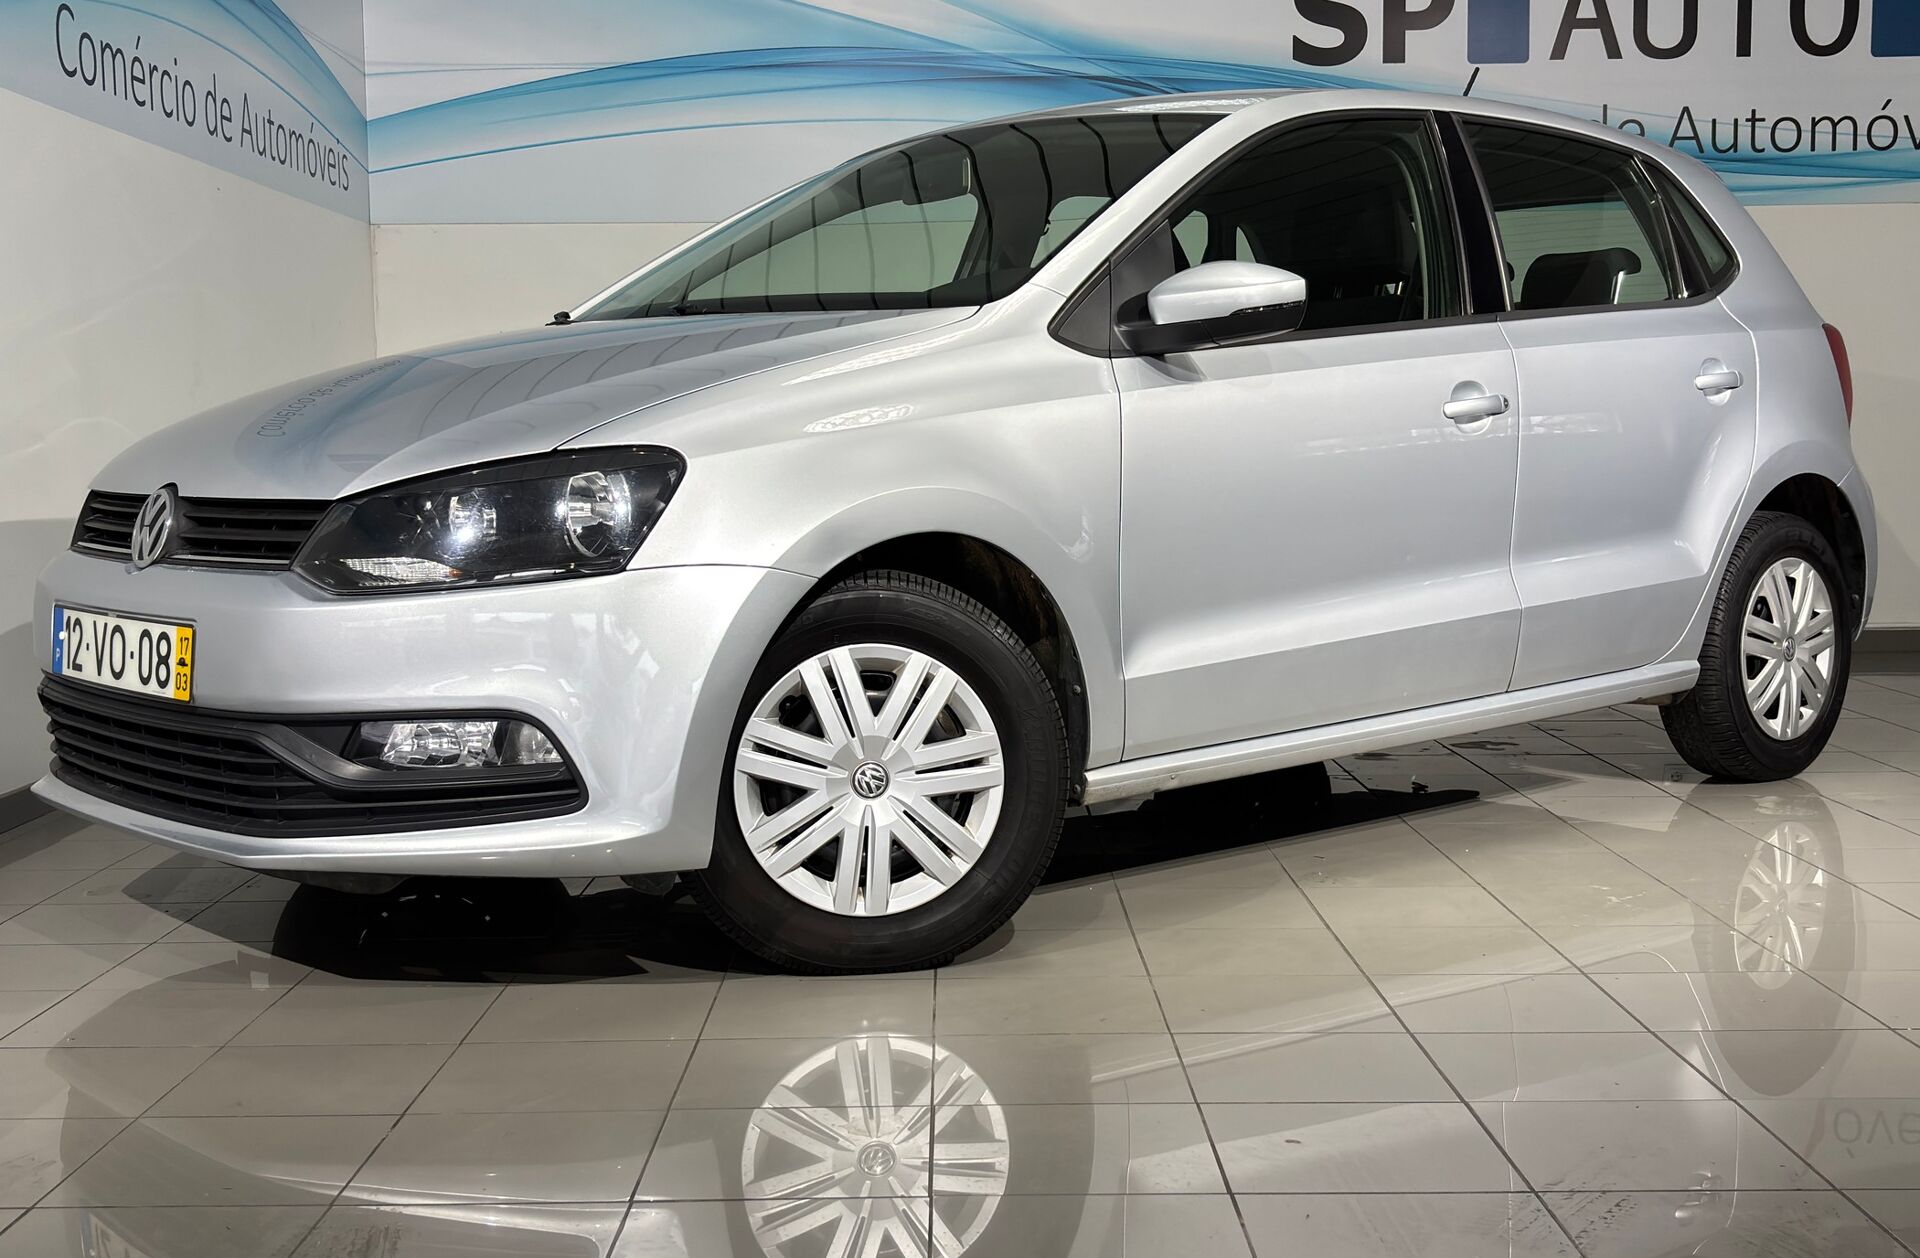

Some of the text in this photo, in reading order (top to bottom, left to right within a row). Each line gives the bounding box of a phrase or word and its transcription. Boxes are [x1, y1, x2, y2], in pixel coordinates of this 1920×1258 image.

[56, 3, 350, 192] Comércio de Automóveis
[180, 636, 190, 656] 17
[175, 672, 188, 692] 03
